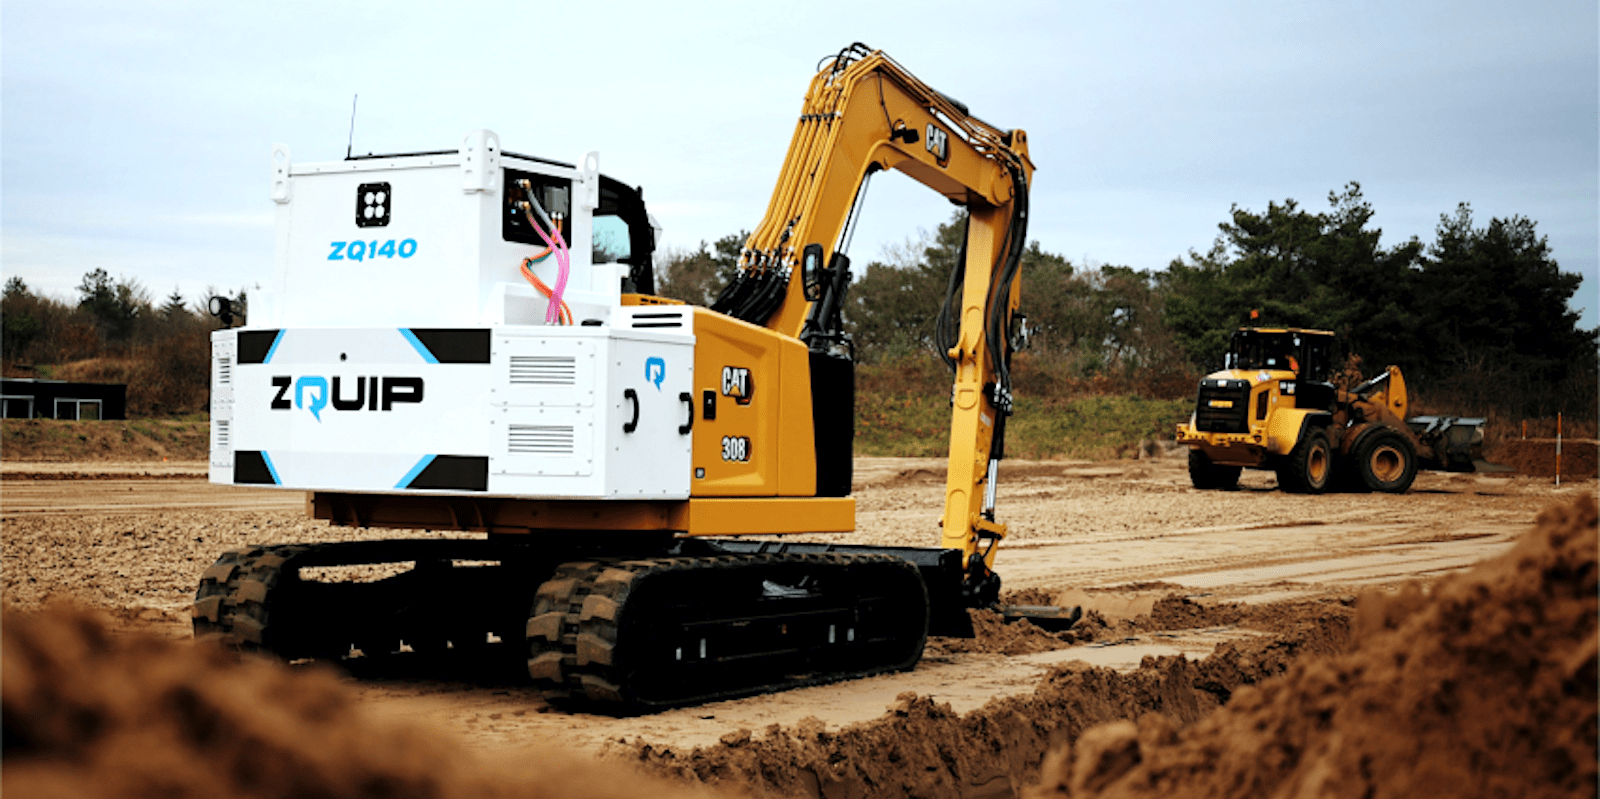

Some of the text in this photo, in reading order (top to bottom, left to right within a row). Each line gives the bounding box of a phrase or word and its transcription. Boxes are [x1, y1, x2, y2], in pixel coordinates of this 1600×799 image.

[926, 123, 947, 159] CAT
[327, 238, 418, 262] ZQ140
[721, 367, 748, 398] CAT
[270, 375, 424, 423] ZQUIP
[721, 437, 746, 461] 308
